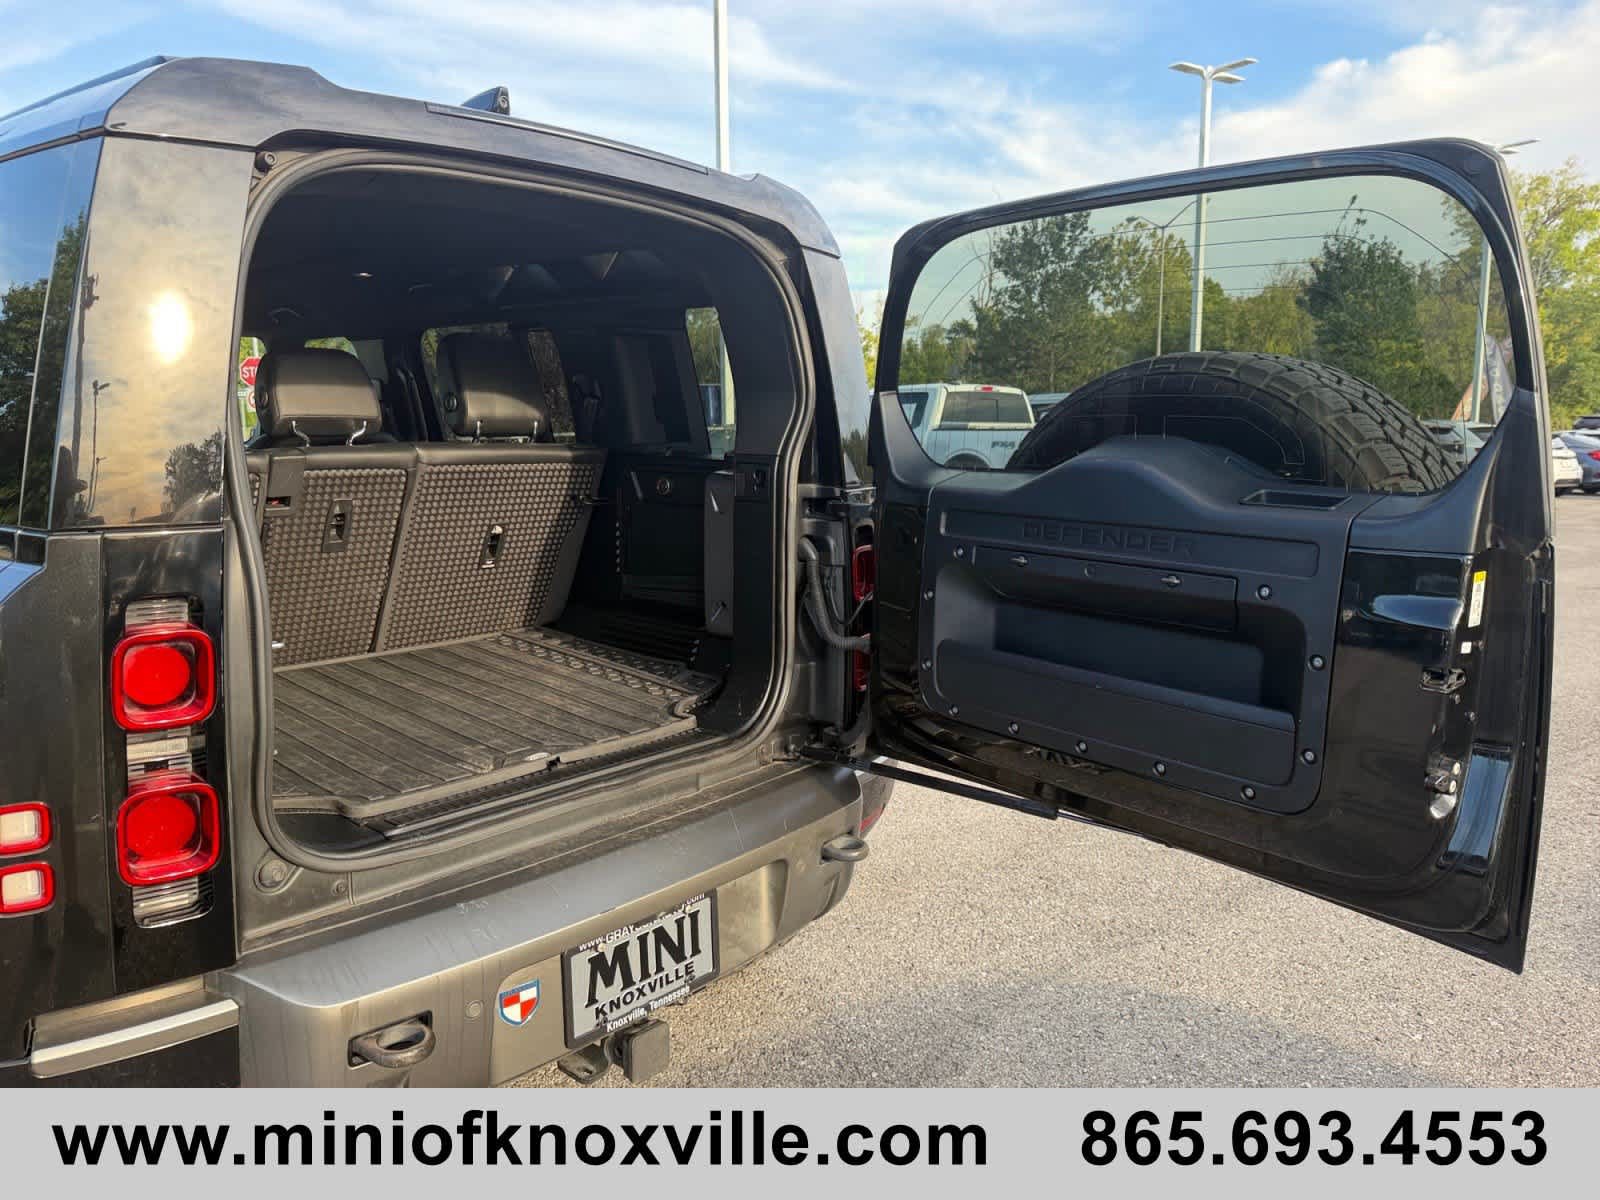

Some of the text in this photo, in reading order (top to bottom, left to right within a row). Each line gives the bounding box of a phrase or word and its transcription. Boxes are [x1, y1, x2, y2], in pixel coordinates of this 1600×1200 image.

[242, 367, 258, 378] ST
[1022, 520, 1195, 560] DEFENDER
[584, 909, 702, 1009] MINI
[595, 961, 695, 1020] KNOXVILLE
[649, 986, 691, 1012] Tennessee
